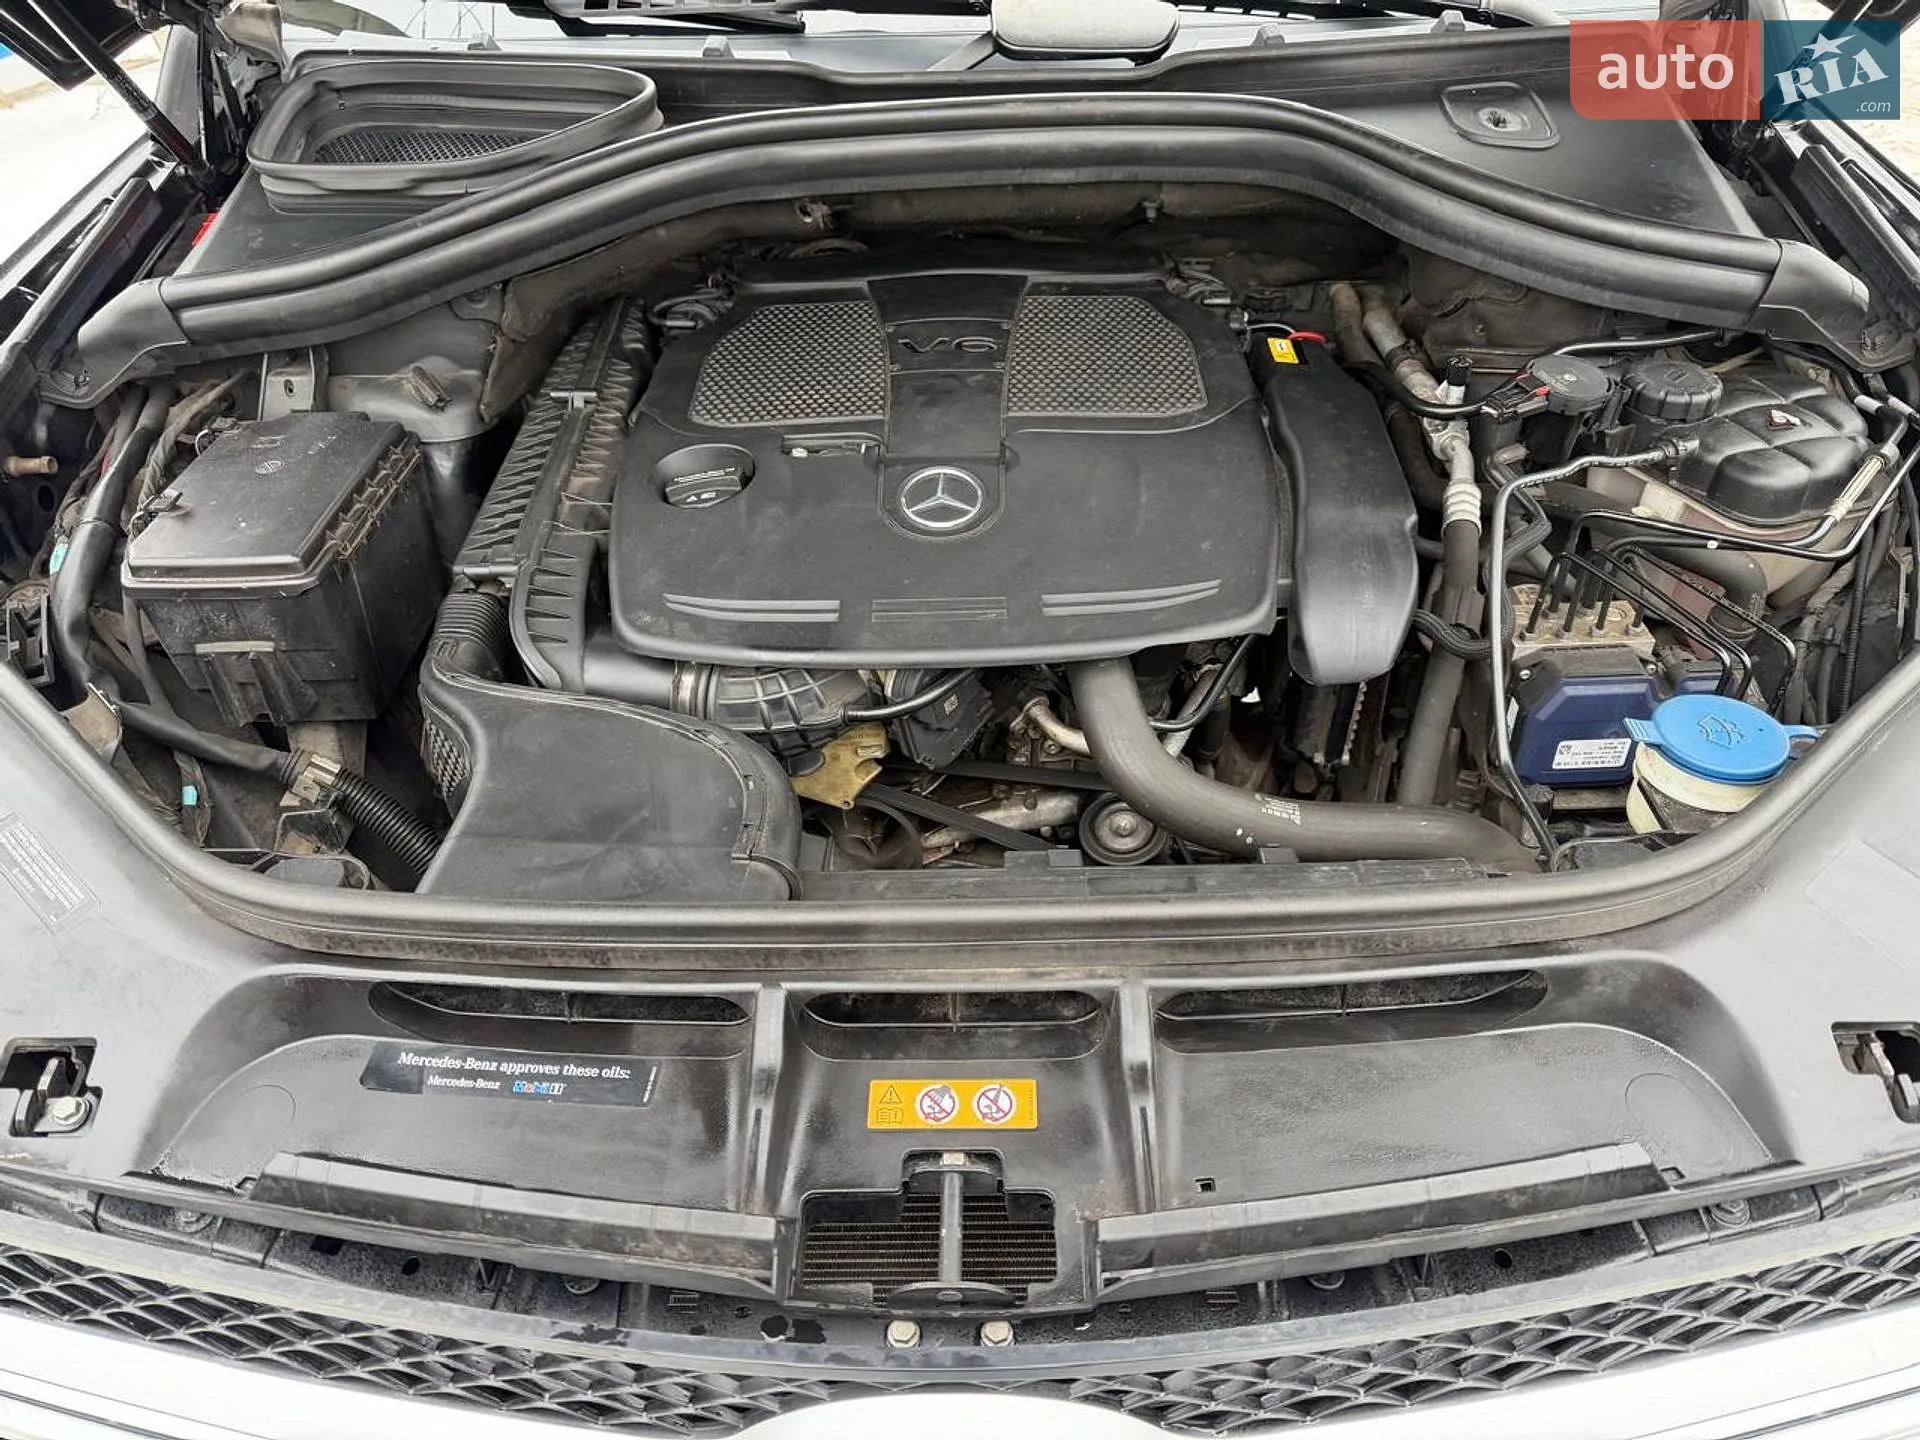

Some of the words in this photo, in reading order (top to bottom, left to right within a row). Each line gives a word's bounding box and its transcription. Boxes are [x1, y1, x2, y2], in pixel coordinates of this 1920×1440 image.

[898, 336, 998, 353] V6
[397, 1052, 498, 1071] Mercedes-Benz
[499, 1062, 560, 1076] approves
[563, 1063, 600, 1077] these
[602, 1066, 631, 1079] oils:
[427, 1075, 501, 1089] Mercedes-Benz
